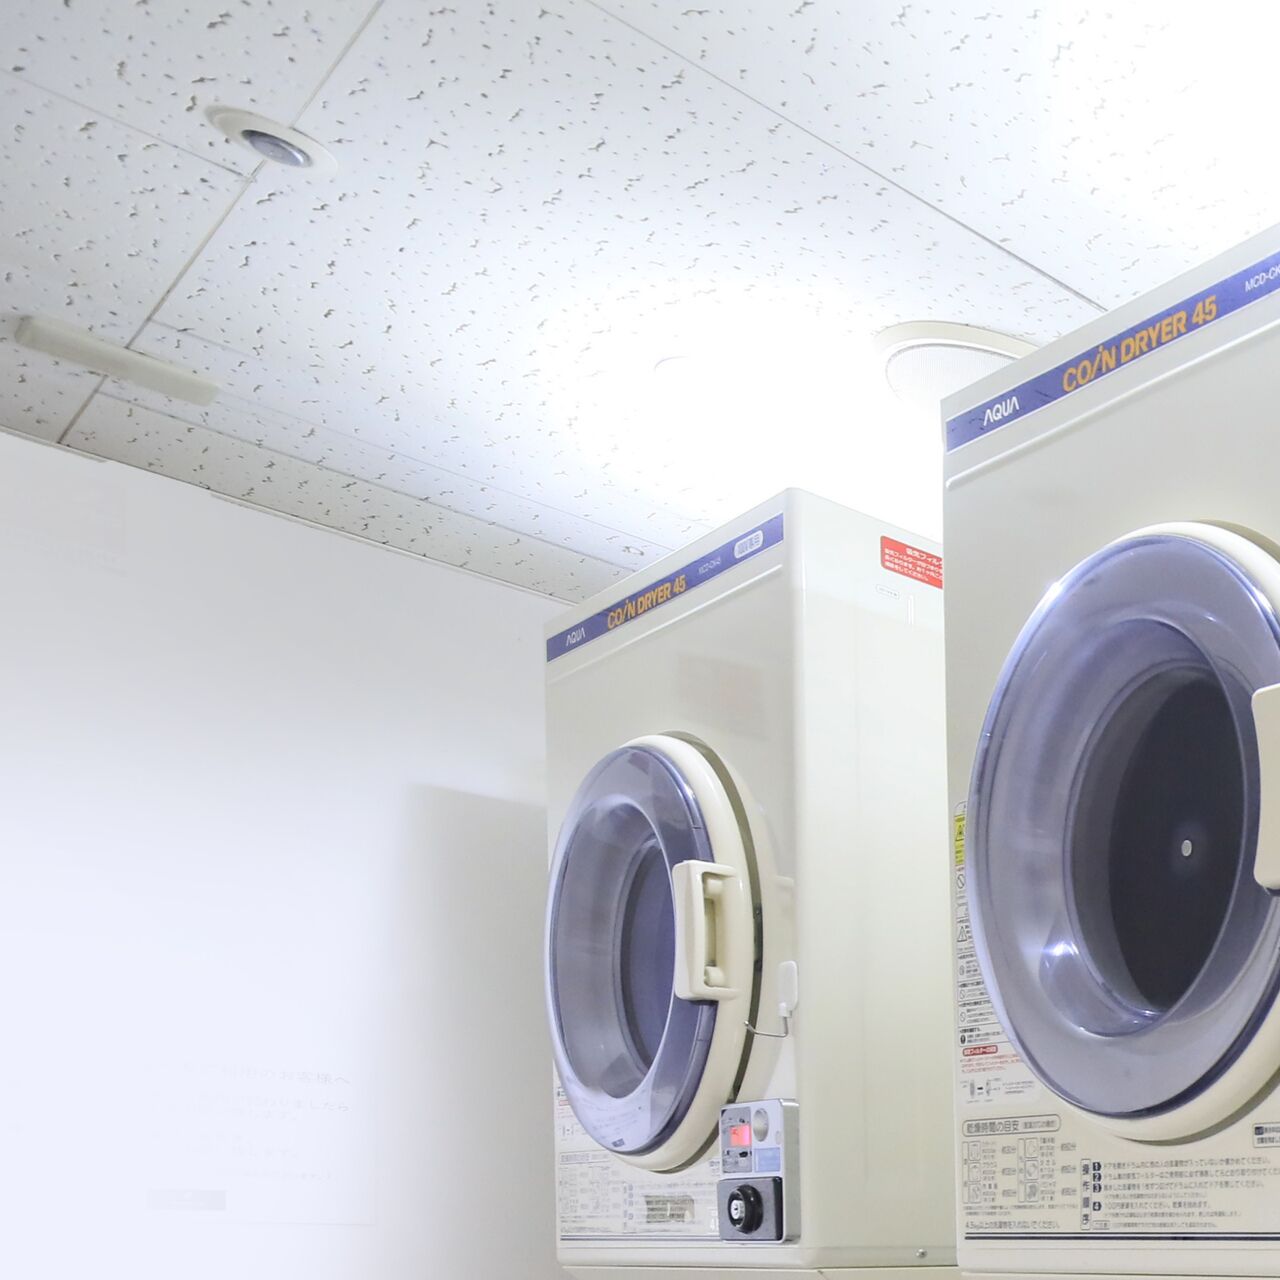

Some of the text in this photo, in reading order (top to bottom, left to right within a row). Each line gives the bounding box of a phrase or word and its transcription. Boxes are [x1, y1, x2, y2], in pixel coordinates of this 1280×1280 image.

[982, 396, 1020, 426] AQUA
[1063, 344, 1117, 393] COIN
[1119, 310, 1188, 365] DRYER
[1191, 296, 1218, 330] 45
[565, 626, 586, 647] AQUA
[607, 595, 636, 631] COIN
[637, 582, 672, 615] DRYER
[673, 575, 686, 594] 45
